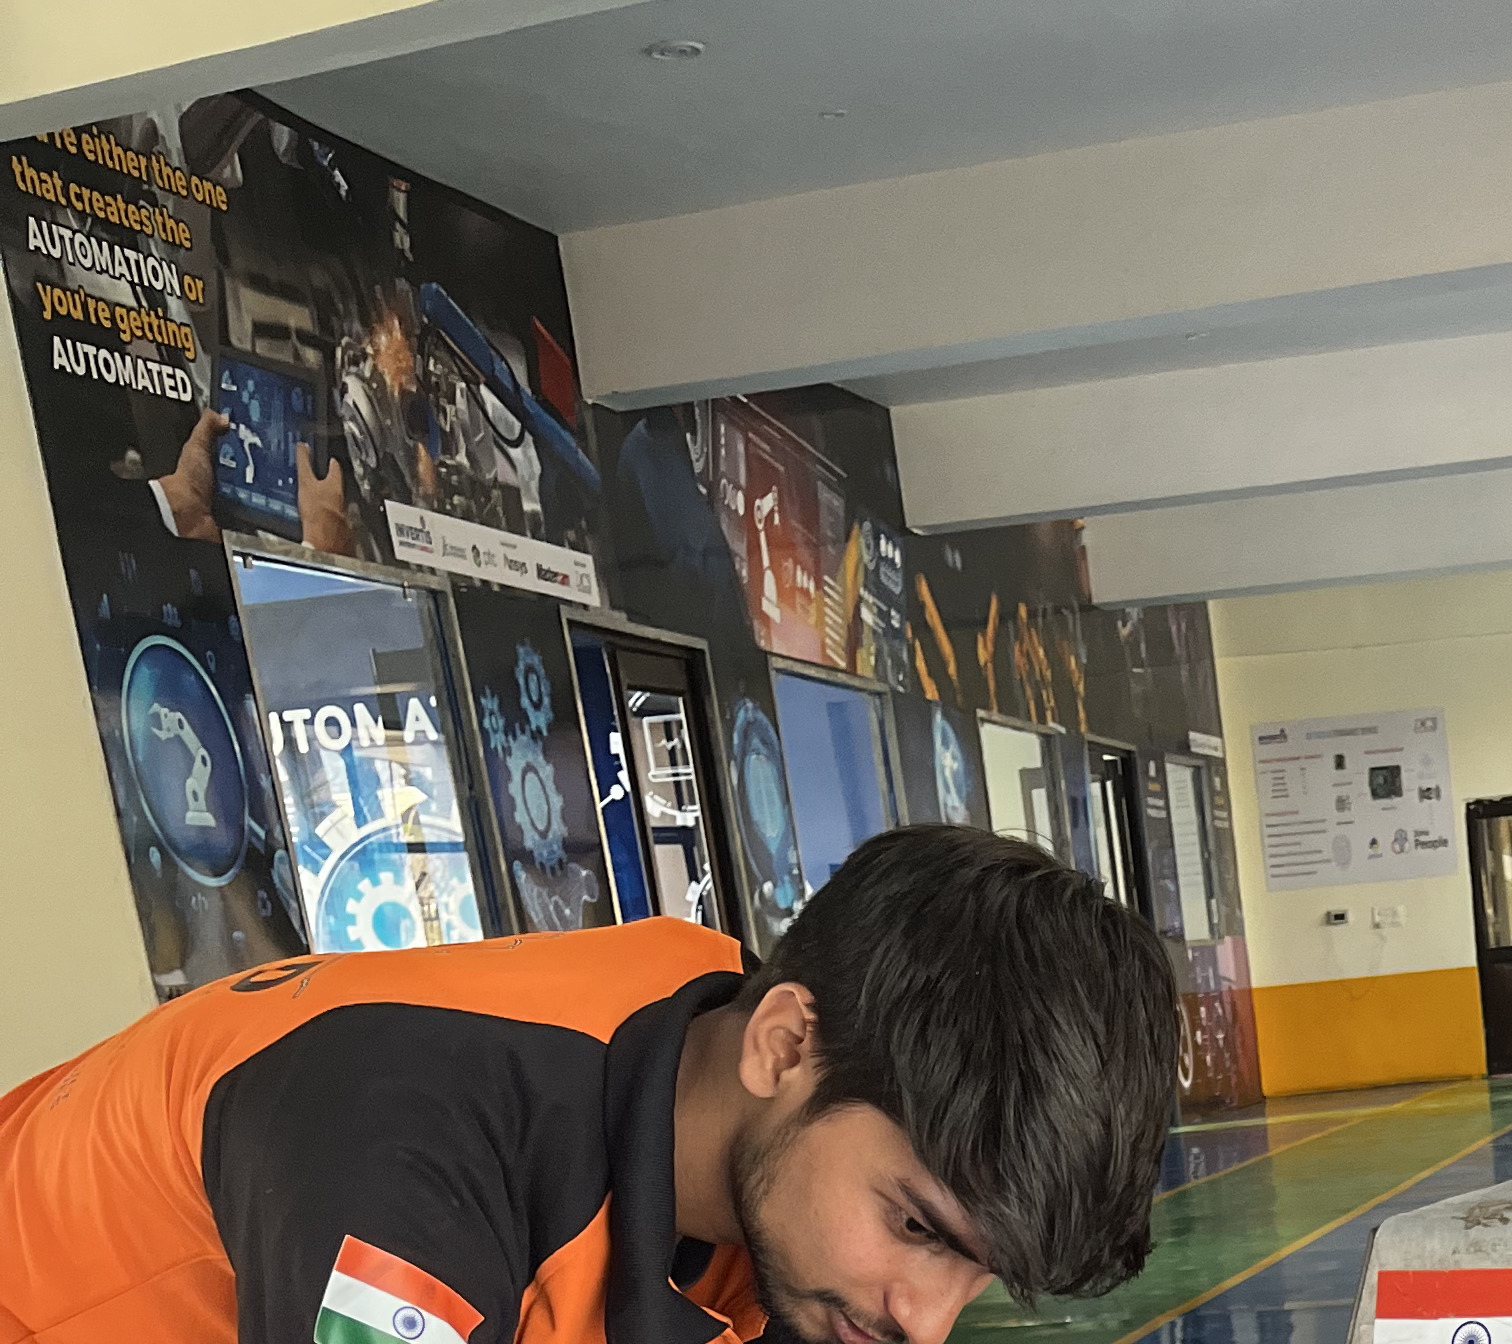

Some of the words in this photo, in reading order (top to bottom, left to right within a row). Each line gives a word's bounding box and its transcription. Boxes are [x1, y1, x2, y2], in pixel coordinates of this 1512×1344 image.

[11, 155, 67, 206] that
[69, 182, 153, 236] creates
[155, 207, 191, 249] the
[81, 125, 148, 181] either
[150, 154, 188, 197] the
[190, 176, 228, 211] one
[28, 216, 182, 297] AUTOMATION
[183, 275, 204, 304] or
[36, 281, 112, 328] you're
[114, 303, 196, 360] getting
[52, 335, 193, 402] AUTOMATED
